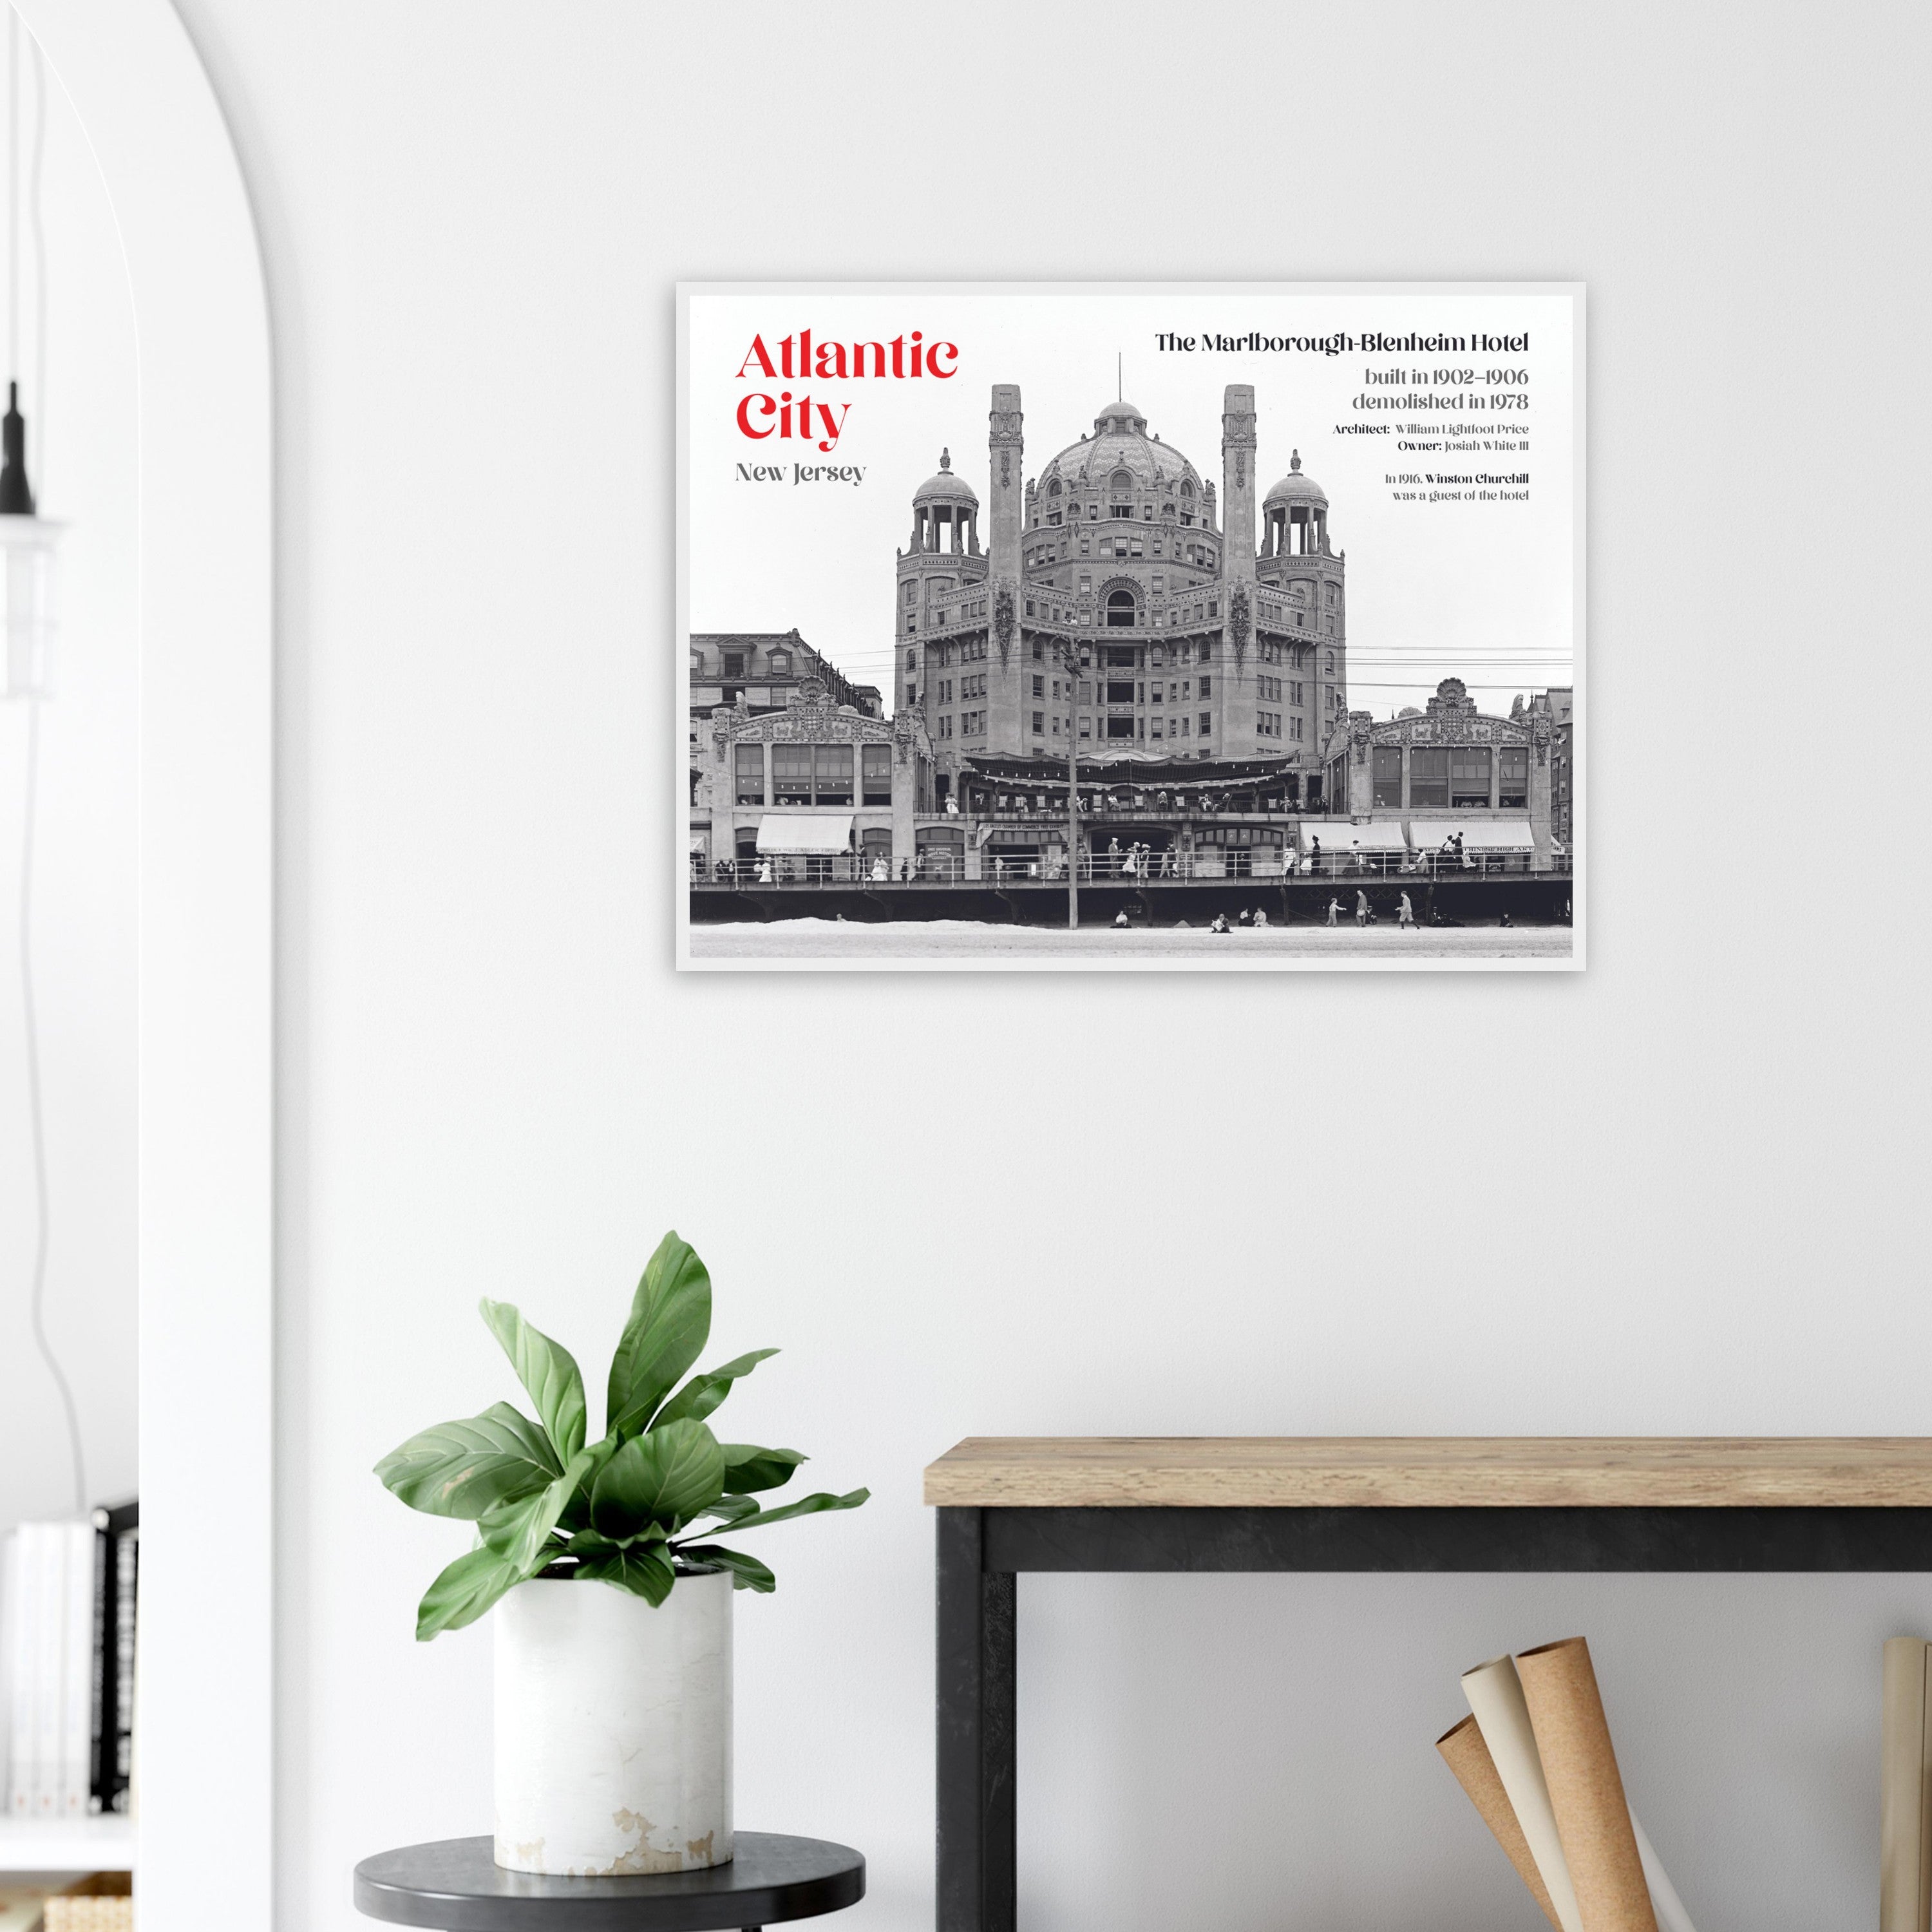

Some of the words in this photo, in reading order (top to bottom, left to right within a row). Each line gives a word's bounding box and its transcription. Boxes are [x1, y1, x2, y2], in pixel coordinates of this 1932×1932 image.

[1155, 332, 1196, 352] The
[1201, 332, 1466, 357] Marlborough-Blenheim
[1472, 332, 1529, 352] Hotel
[735, 328, 958, 379] Atlantic
[1365, 368, 1406, 385] built
[1412, 369, 1428, 384] in
[1352, 393, 1464, 410] demolished
[1469, 394, 1485, 410] in
[1491, 393, 1529, 410] 1978
[737, 392, 852, 452] City
[1332, 424, 1390, 435] Architect:
[1395, 424, 1440, 435] William
[1442, 424, 1495, 437] Lightfoot
[1497, 424, 1530, 435] Price
[1397, 440, 1443, 451] Owner:
[1444, 440, 1481, 453] Josiah
[1482, 440, 1517, 451] White
[1519, 441, 1530, 451] III
[735, 462, 788, 482] New
[793, 462, 867, 487] Jersey
[1385, 474, 1396, 484] In
[1399, 474, 1423, 484] 1916.
[1425, 474, 1473, 484] Winston
[1475, 473, 1530, 484] Churchill
[1392, 492, 1417, 500] was
[1419, 492, 1426, 500] a
[1428, 490, 1462, 503] guest
[1464, 490, 1476, 500] of
[1479, 490, 1498, 500] the
[1500, 490, 1530, 500] hotel
